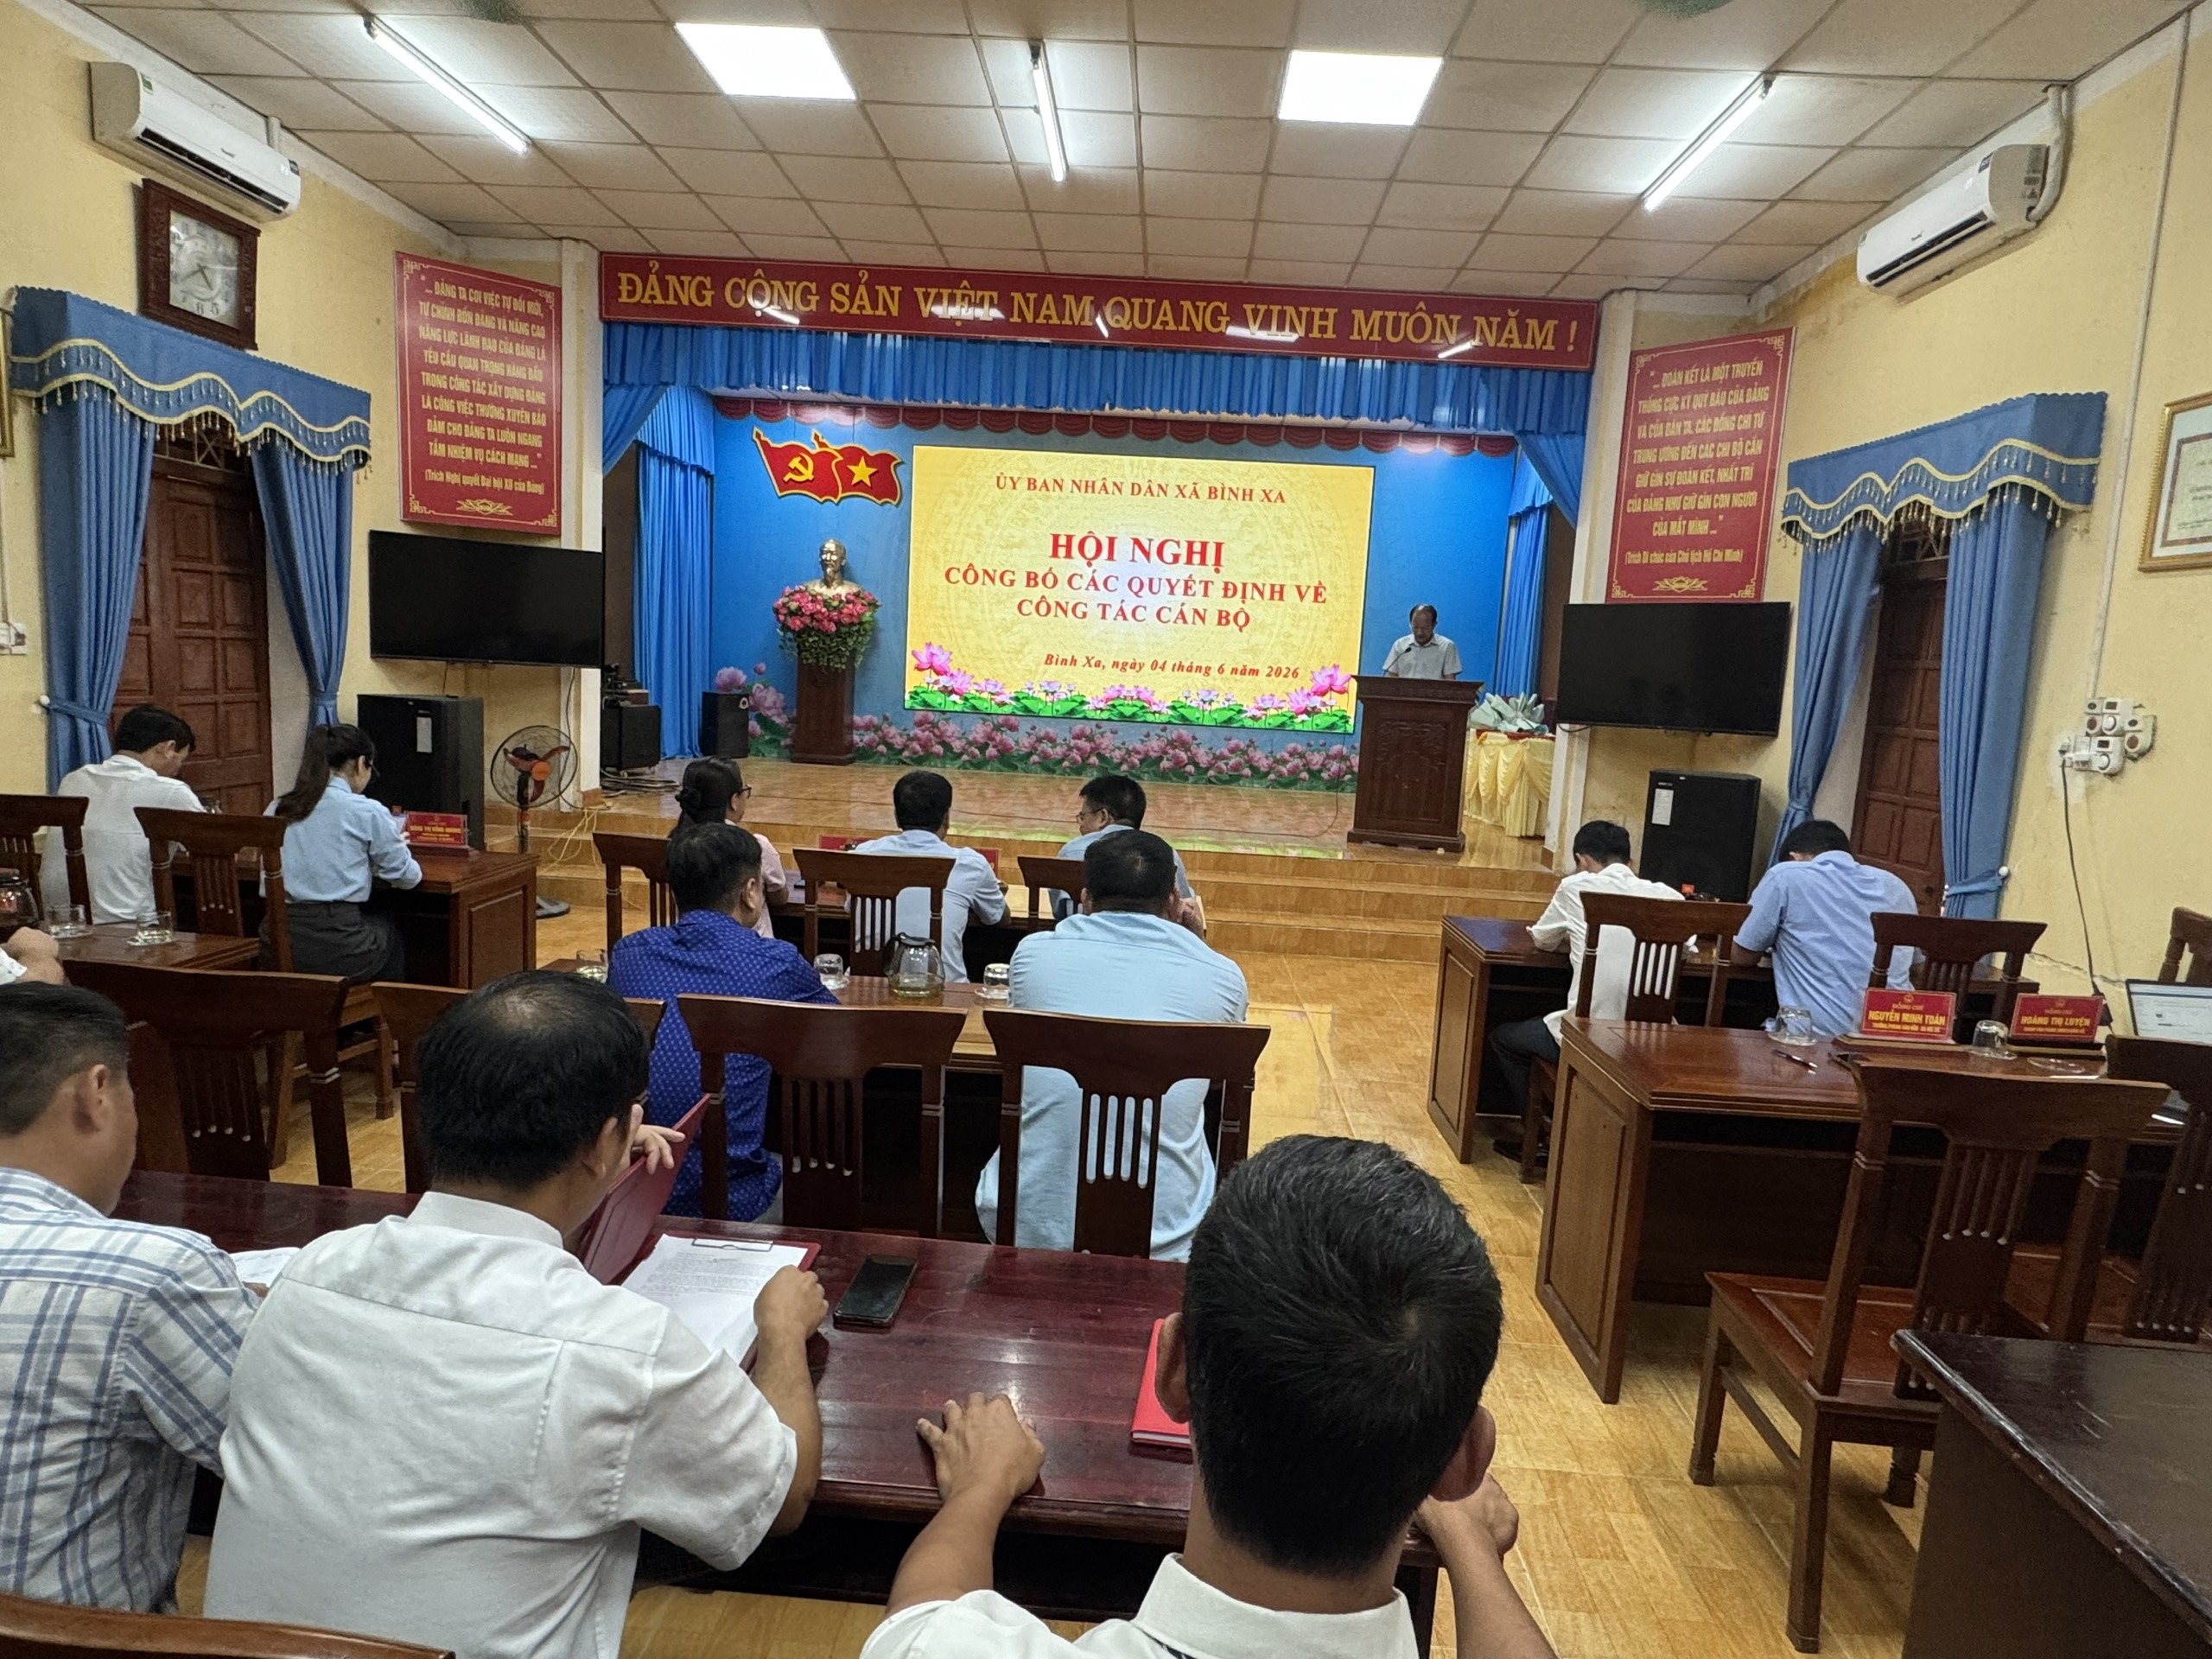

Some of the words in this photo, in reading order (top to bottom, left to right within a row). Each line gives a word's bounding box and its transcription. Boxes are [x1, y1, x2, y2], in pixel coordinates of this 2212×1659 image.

[458, 286, 467, 301] TA
[617, 260, 715, 307] ĐẢNG
[725, 269, 819, 317] CỘNG
[830, 270, 902, 316] SẢN
[913, 280, 999, 327] VIỆT
[1010, 291, 1094, 327] NAM
[1104, 296, 1230, 333] QUANG
[1243, 304, 1338, 339] VINH
[1351, 302, 1459, 344] MUÔN
[1471, 308, 1558, 351] NĂM
[1567, 321, 1577, 352] !
[427, 415, 445, 434] ĐẢM
[447, 422, 462, 436] CHO
[464, 421, 485, 440] ĐẢNG
[486, 427, 496, 441] TA
[497, 428, 516, 444] LUÔN
[518, 432, 543, 448] NGANG
[448, 444, 473, 462] NHIỆM
[474, 448, 484, 465] VỤ
[486, 448, 505, 465] CÁCH
[996, 472, 1021, 490] ỦY
[1027, 477, 1065, 493] BAN
[1070, 478, 1124, 495] NHÂN
[1130, 479, 1168, 497] DÂN
[1174, 482, 1200, 499] XÃ
[1207, 482, 1254, 501] BÌNH
[1261, 488, 1286, 503] XA
[1049, 531, 1118, 568] HỘI
[1129, 537, 1224, 574] NGHỊ
[944, 562, 1016, 588] CÔNG
[1025, 567, 1058, 589] BỐ
[1067, 569, 1119, 593] CÁC
[1128, 574, 1214, 597] QUYẾT
[1222, 582, 1286, 604] ĐỊNH
[1017, 595, 1088, 620] CÔNG
[1096, 599, 1147, 623] TÁC
[1156, 602, 1207, 626] CÁN
[1217, 607, 1250, 632] BỘ
[1044, 654, 1077, 667] Bình
[1082, 657, 1106, 671] Xa,
[1111, 658, 1144, 673] ngày
[1150, 659, 1166, 671] 04
[1172, 660, 1211, 677] tháng
[1217, 663, 1225, 674] 6
[1230, 665, 1260, 677] năm
[1266, 665, 1300, 679] 2026
